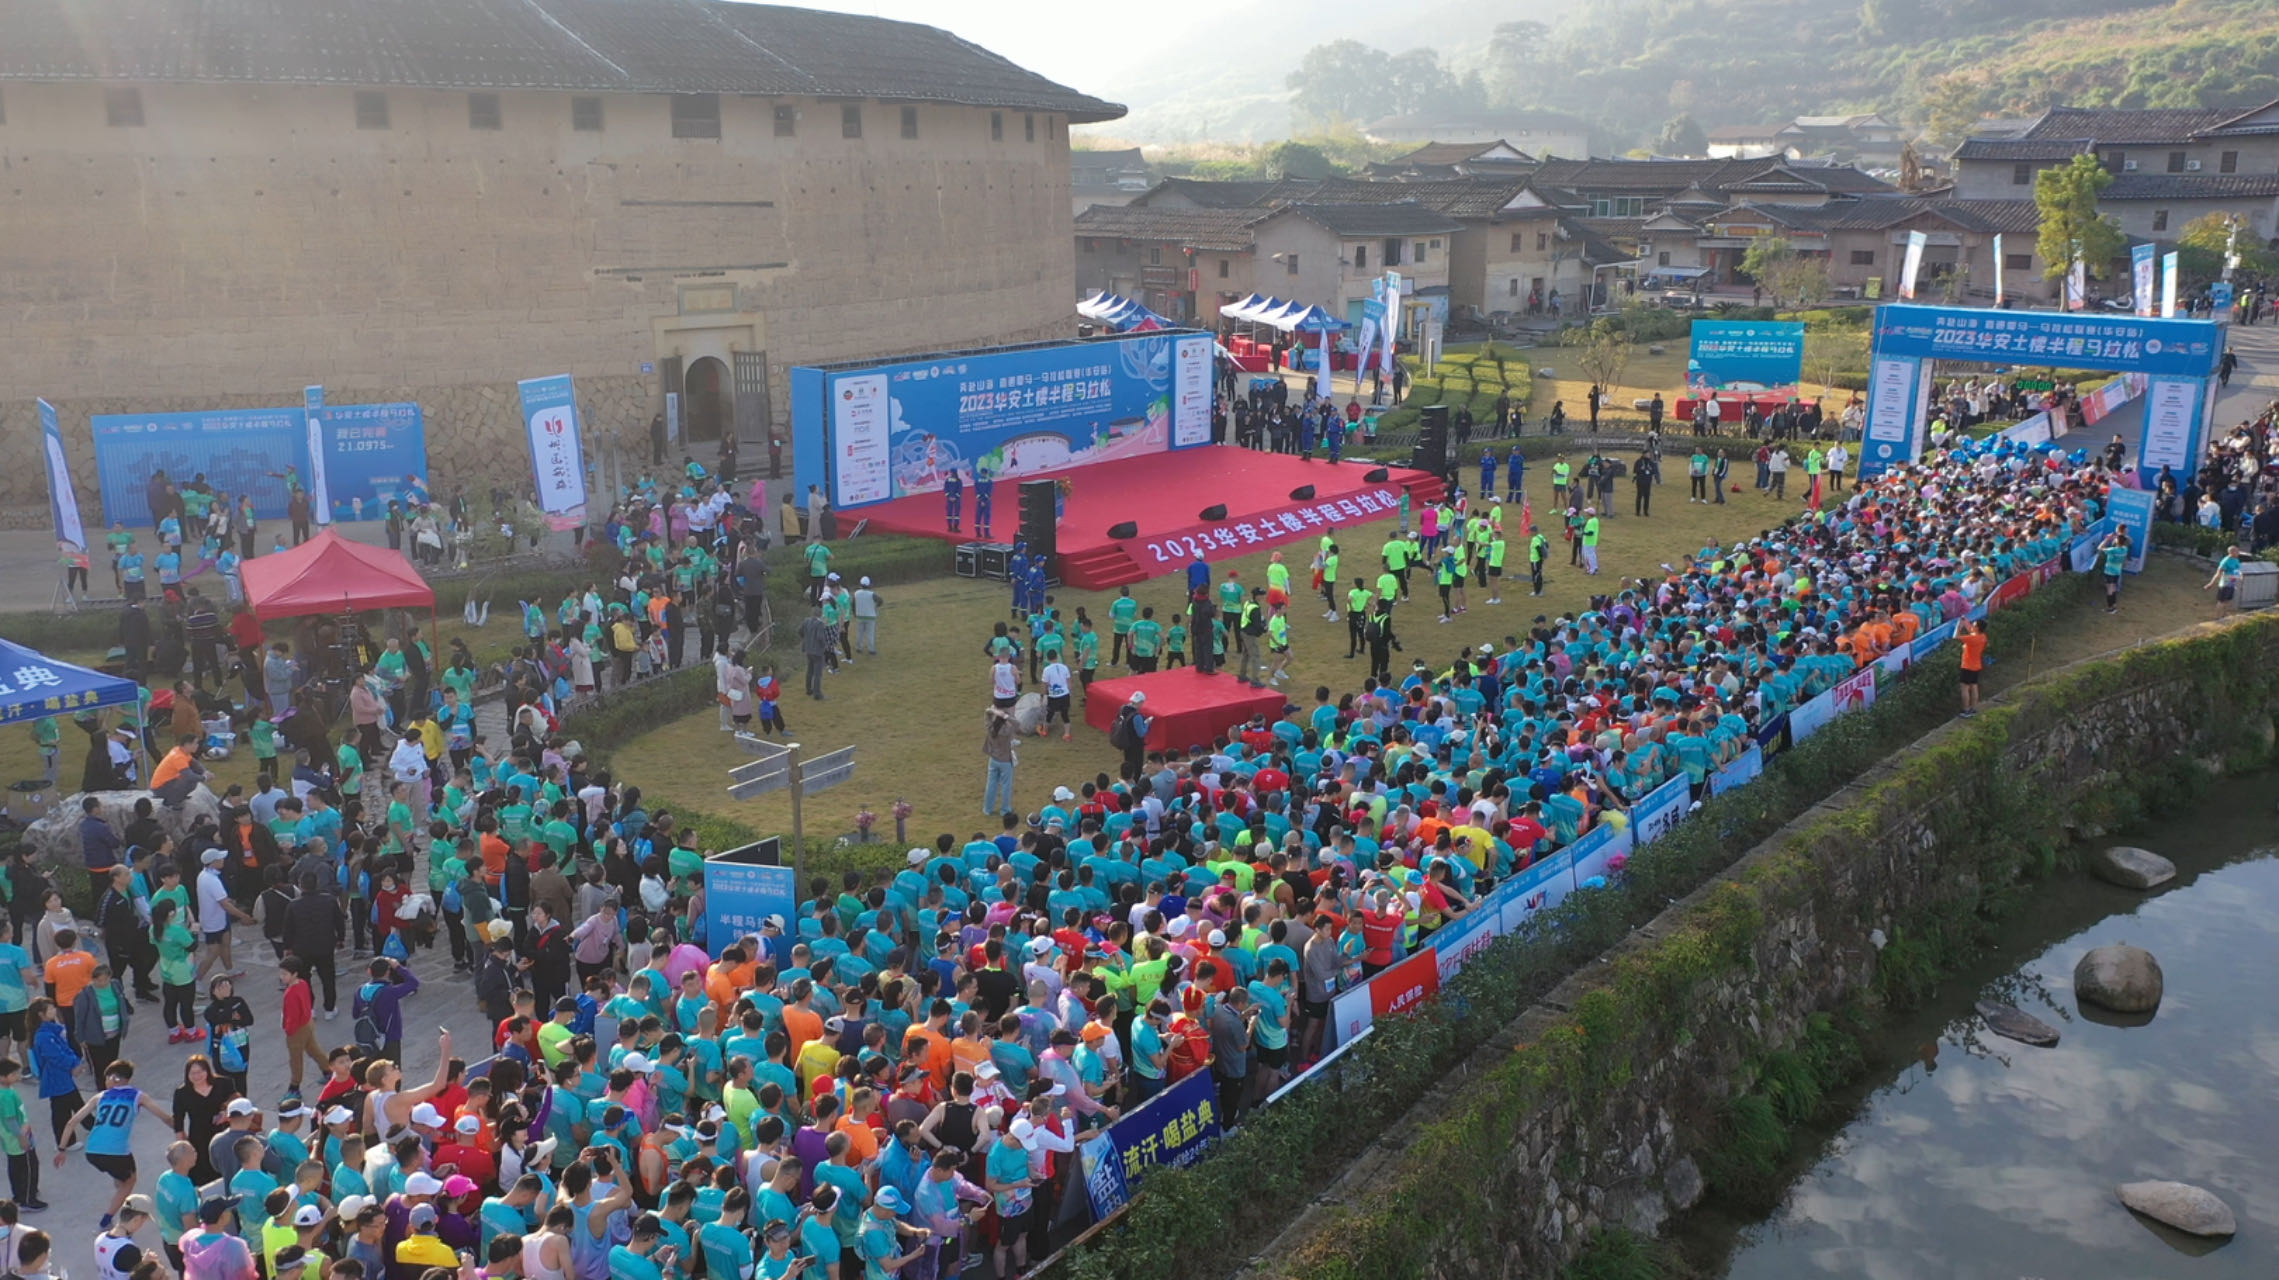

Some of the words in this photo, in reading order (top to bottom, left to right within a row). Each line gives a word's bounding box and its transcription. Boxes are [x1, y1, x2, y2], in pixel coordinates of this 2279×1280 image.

[1933, 329, 2141, 359] 2023华安土楼半程马拉松
[959, 378, 1112, 413] 2023华安土楼半程马拉松
[1147, 489, 1400, 562] 2023华安土楼半程马拉松
